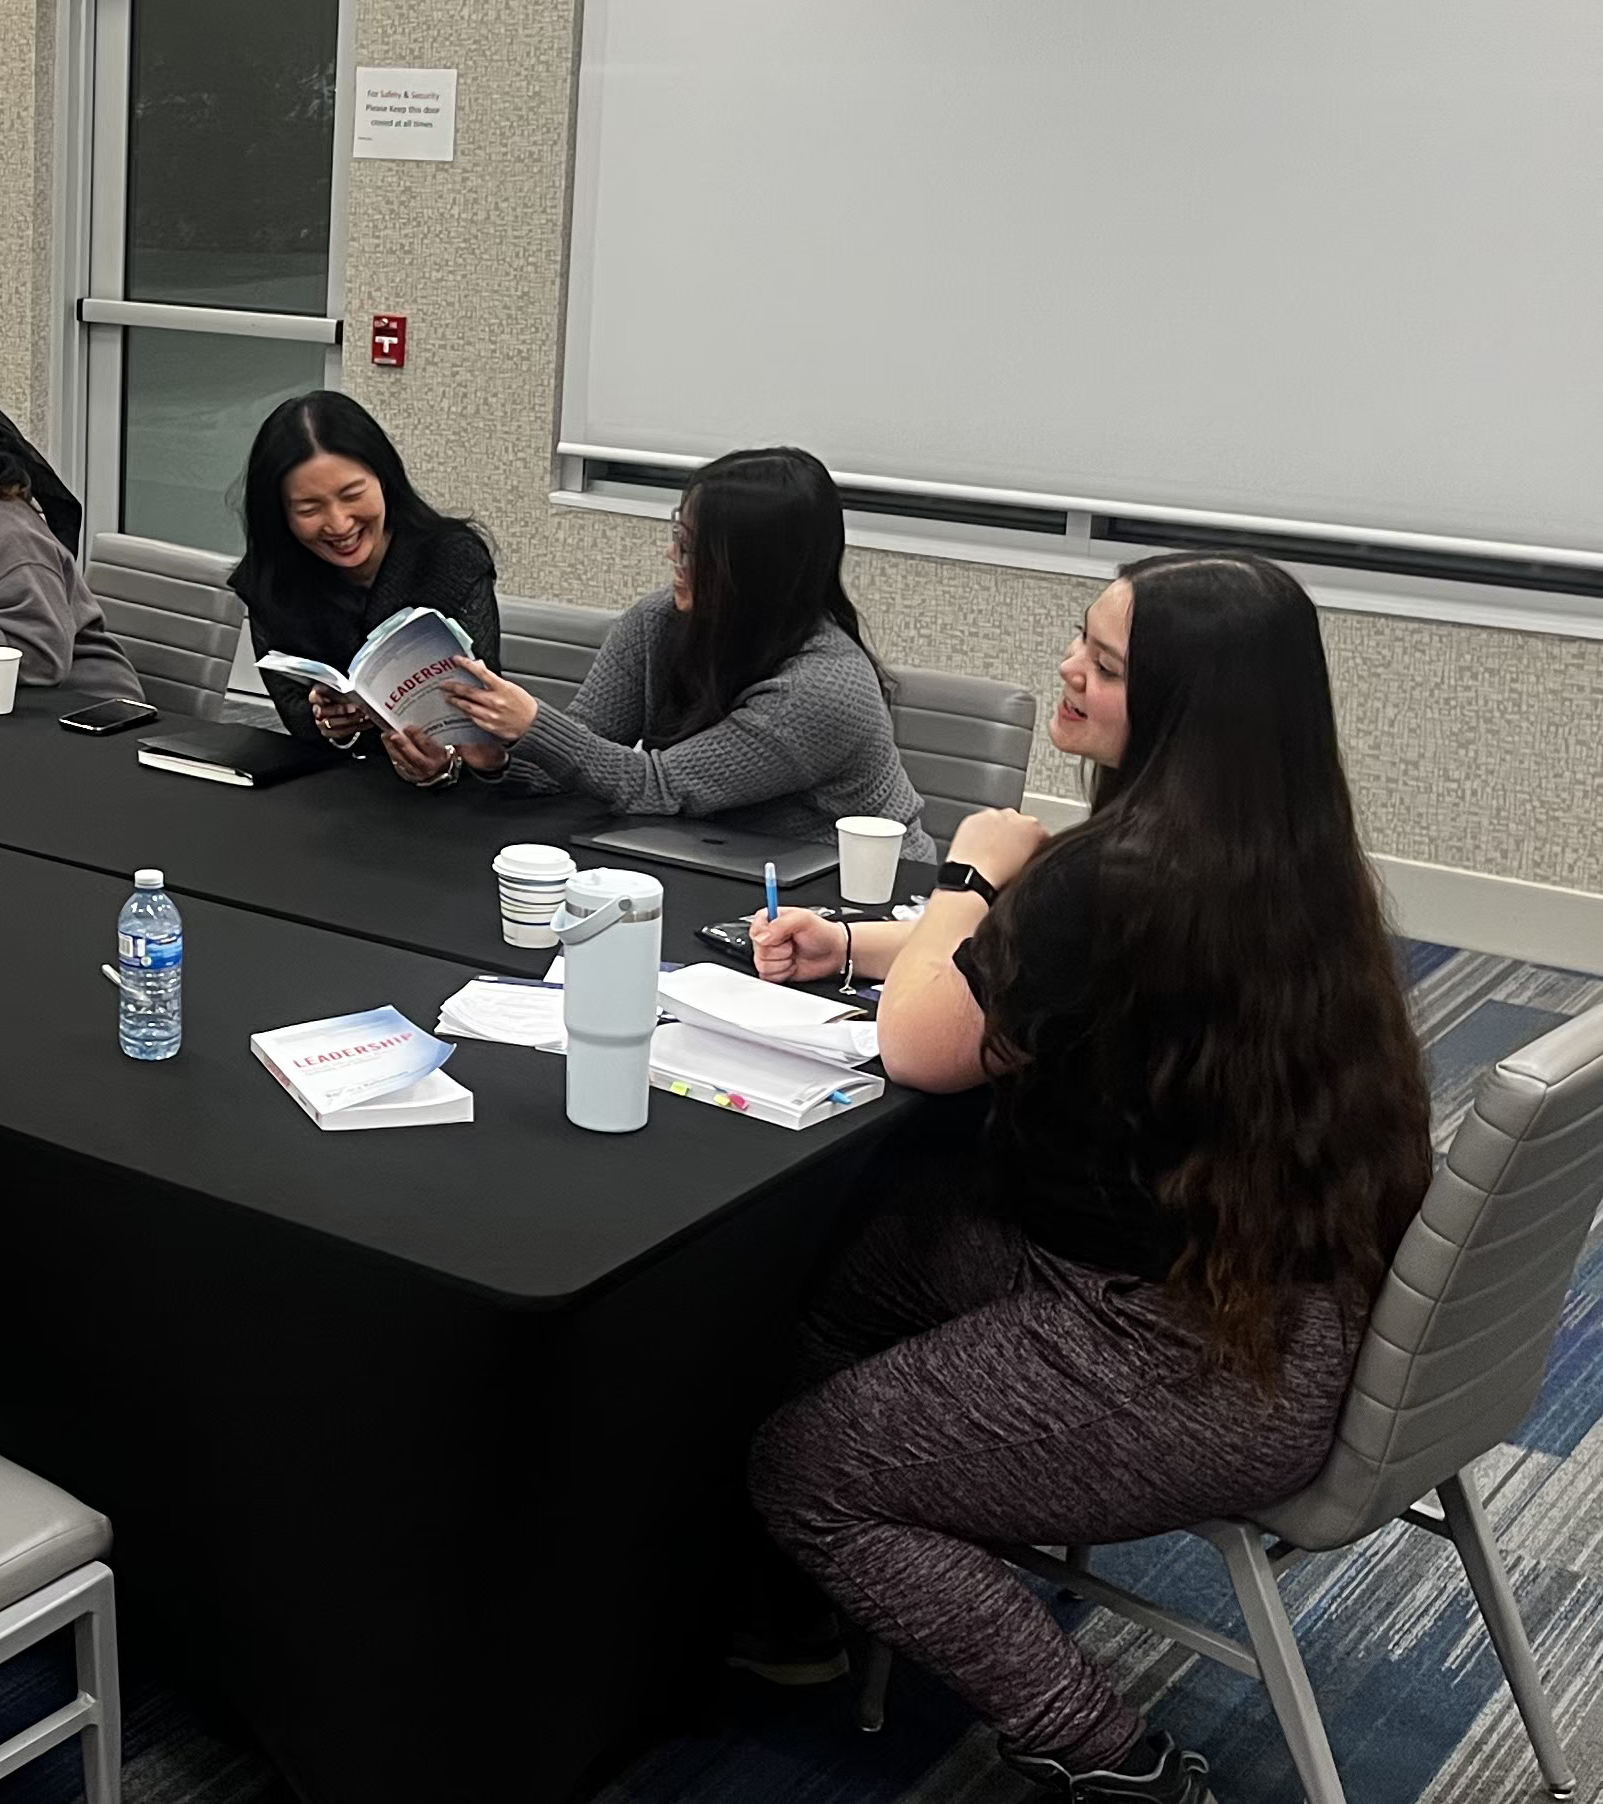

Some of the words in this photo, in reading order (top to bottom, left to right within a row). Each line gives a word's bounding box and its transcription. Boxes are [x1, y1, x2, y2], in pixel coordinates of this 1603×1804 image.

[367, 89, 378, 98] For
[366, 104, 388, 112] Please
[385, 656, 458, 711] LEADERSHI
[293, 1032, 413, 1069] LEADERSHIP
